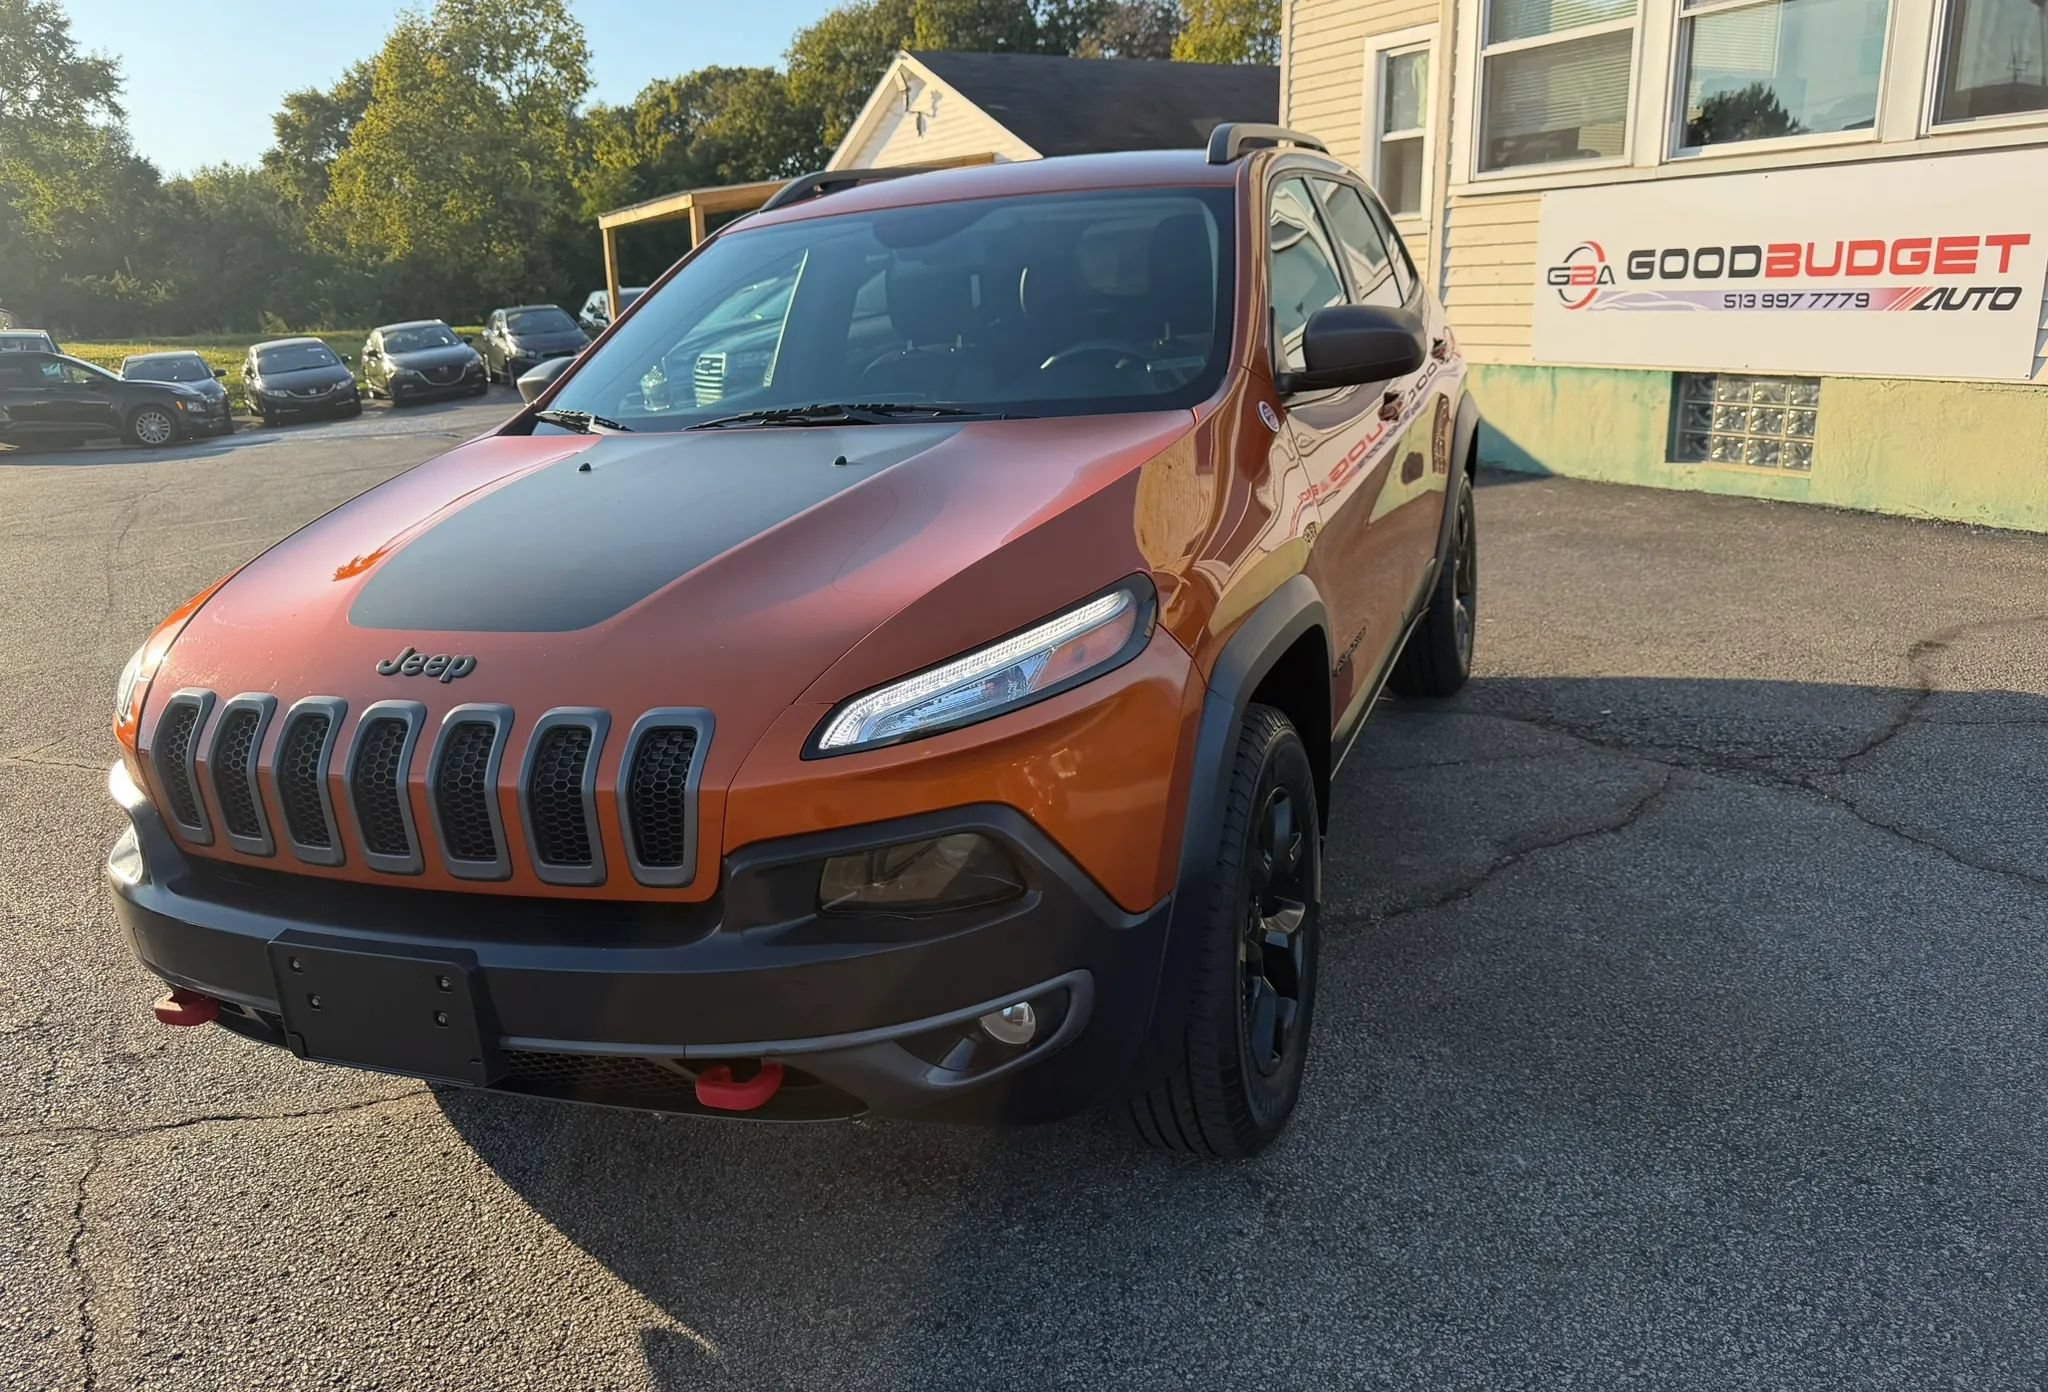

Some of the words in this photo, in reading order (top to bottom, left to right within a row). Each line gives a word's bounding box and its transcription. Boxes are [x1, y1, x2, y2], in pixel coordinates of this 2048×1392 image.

[1547, 266, 1616, 287] GBA
[1724, 293, 1757, 309] 513
[1761, 293, 1805, 309] 997
[1808, 292, 1870, 309] 7779
[1914, 286, 2022, 311] AUTO
[376, 646, 478, 683] Jeep
